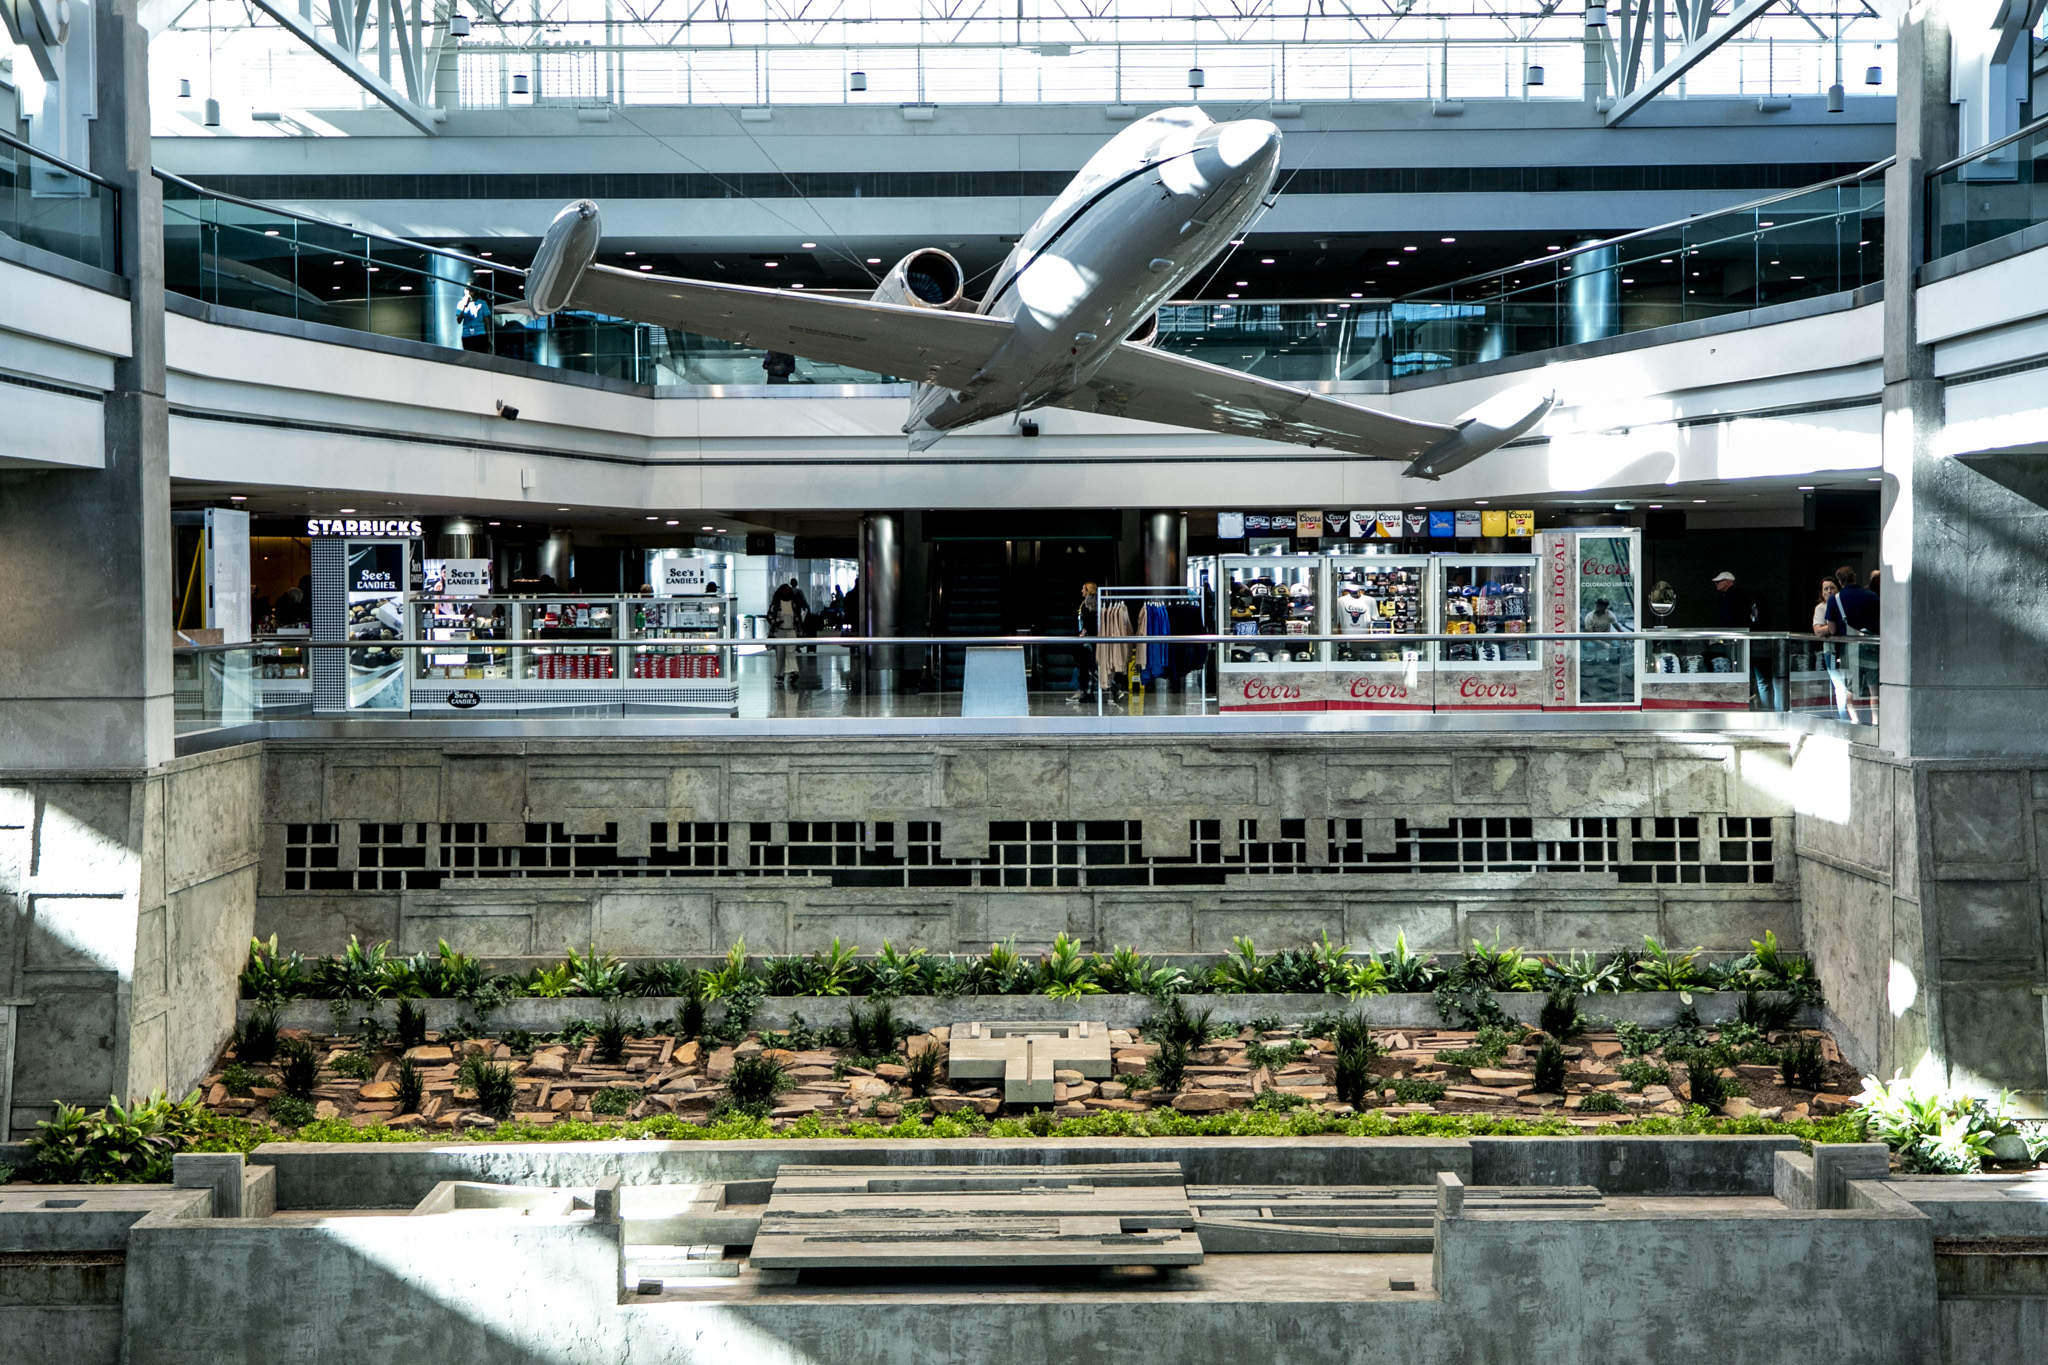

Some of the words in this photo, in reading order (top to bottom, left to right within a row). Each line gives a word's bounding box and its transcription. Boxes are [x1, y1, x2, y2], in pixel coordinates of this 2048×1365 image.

[1299, 512, 1321, 522] Coors
[1378, 512, 1400, 521] Coors
[1508, 511, 1532, 519] Coors
[307, 519, 422, 537] STARBUCKS
[669, 568, 694, 577] See's
[1554, 538, 1565, 597] LOCAL
[1581, 557, 1630, 576] Coors
[361, 569, 391, 581] See's
[451, 568, 475, 578] See's
[357, 581, 396, 590] CANDIES
[1554, 654, 1565, 702] LONG
[1242, 678, 1302, 699] Coors
[1350, 677, 1408, 698] Coors
[1459, 676, 1517, 698] Coors
[454, 691, 474, 699] See's
